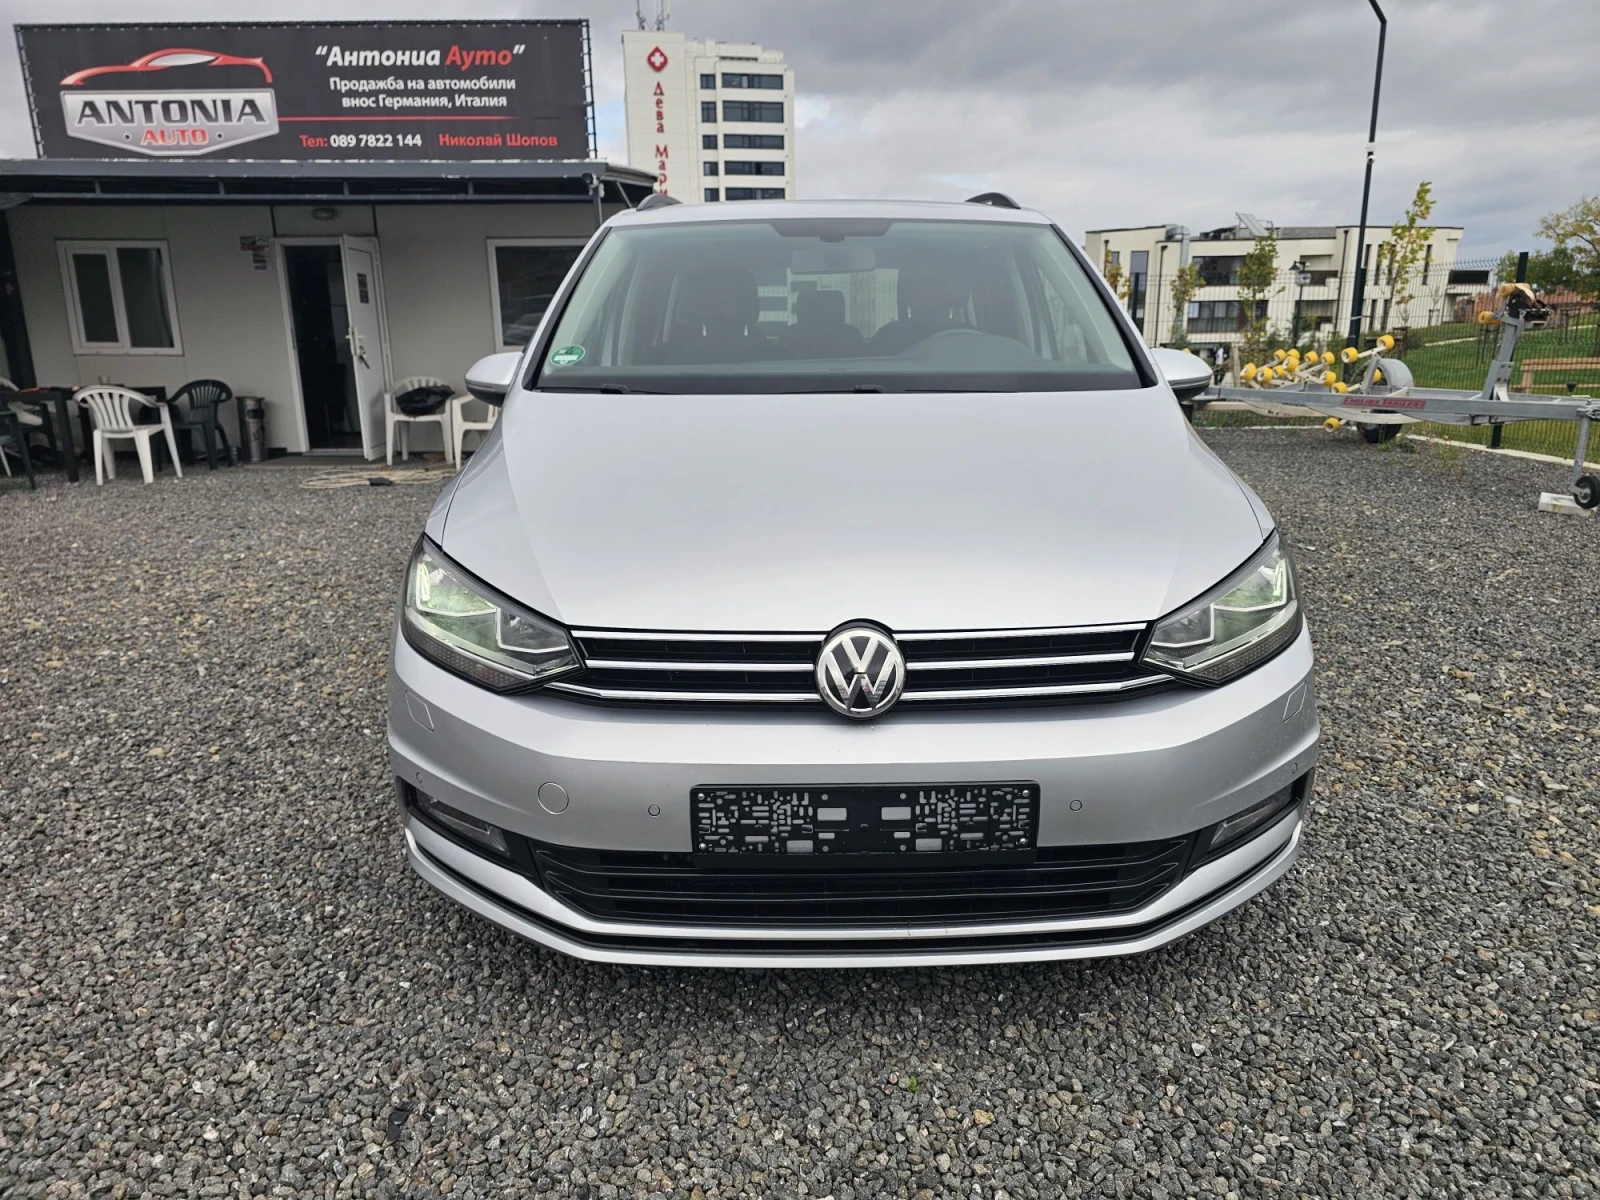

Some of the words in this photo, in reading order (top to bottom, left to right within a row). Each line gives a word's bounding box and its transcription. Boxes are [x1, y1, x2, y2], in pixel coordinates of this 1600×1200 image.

[329, 76, 404, 93] Продажба
[407, 80, 425, 91] на
[427, 76, 516, 91] автомобили
[341, 97, 376, 108] внос
[378, 94, 452, 110] Германия,
[455, 94, 507, 108] Италия
[653, 81, 665, 134] Дева
[76, 99, 268, 125] ANTONIA
[141, 128, 210, 146] AUTO
[300, 134, 328, 147] Тел:
[329, 134, 356, 148] 089
[359, 134, 393, 148] 7822
[397, 134, 422, 148] 144
[439, 133, 502, 147] Николай
[506, 133, 558, 147] Шопов
